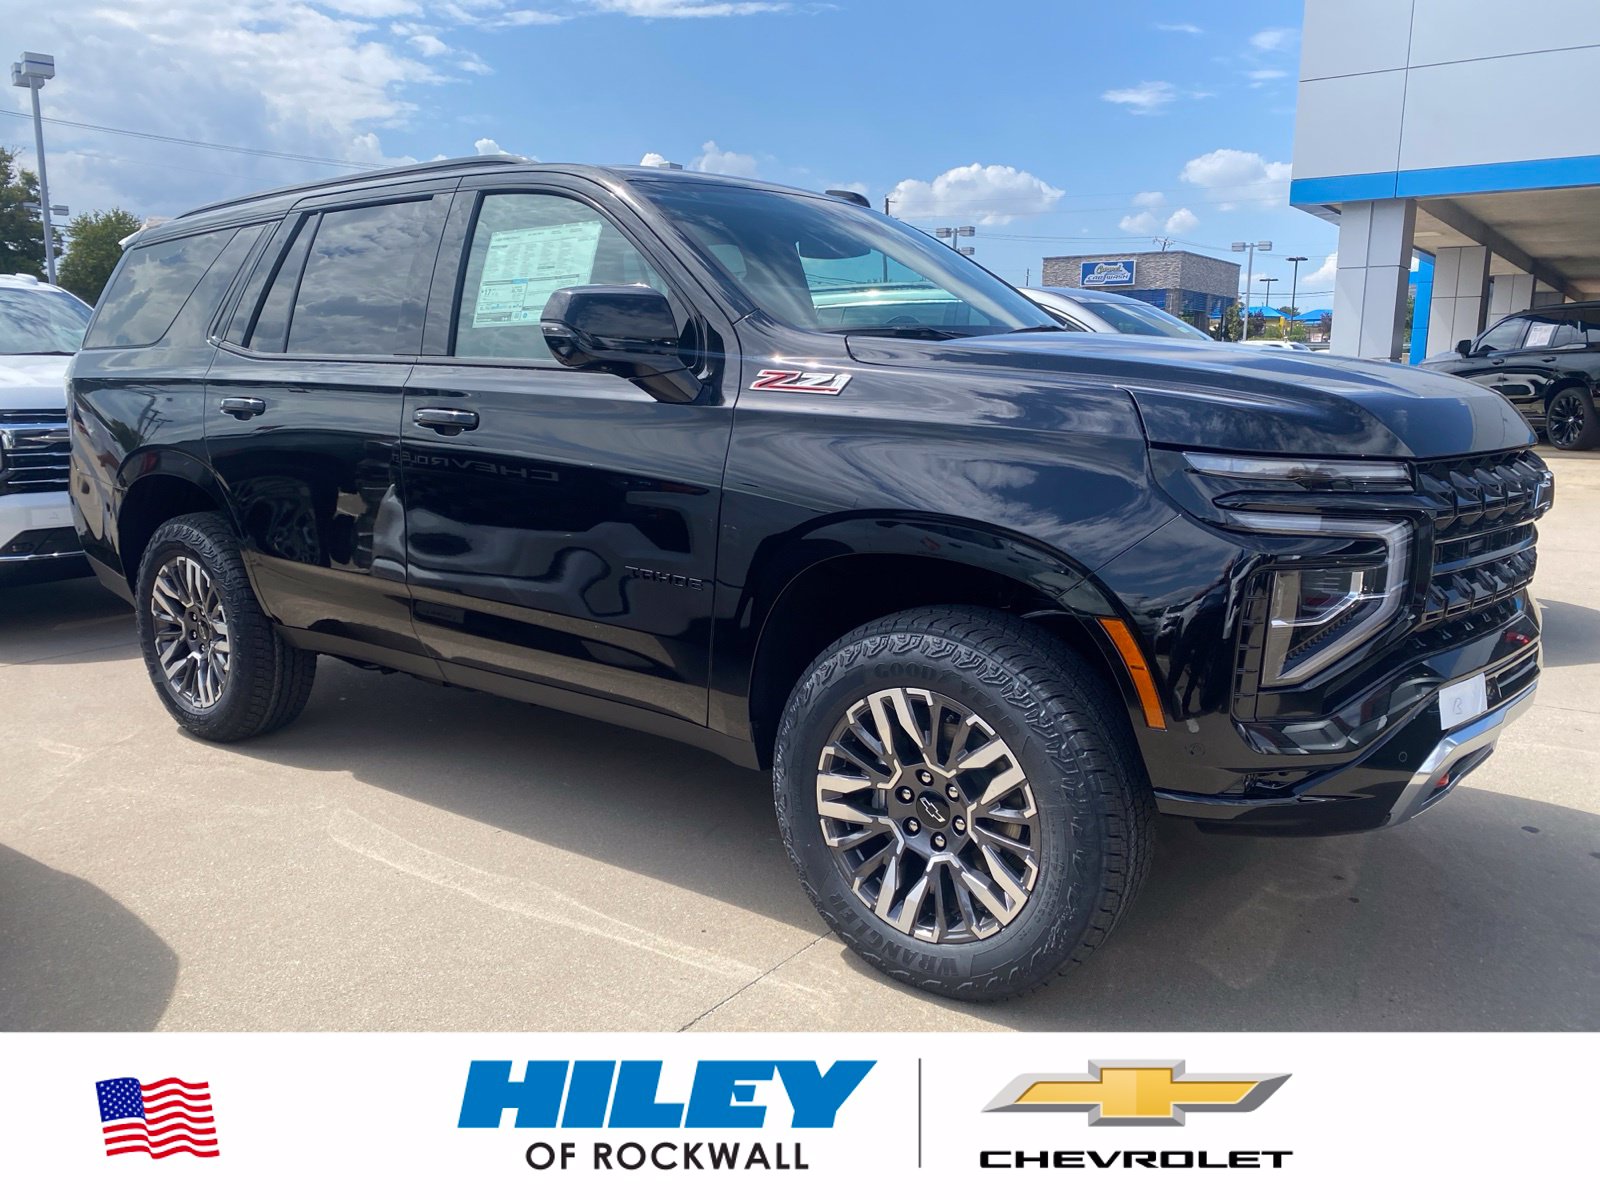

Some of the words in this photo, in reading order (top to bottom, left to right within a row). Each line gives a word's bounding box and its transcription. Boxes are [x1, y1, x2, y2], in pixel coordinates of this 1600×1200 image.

[749, 369, 853, 396] Z71
[624, 565, 704, 592] TAHOE
[829, 891, 960, 977] WRANGLER
